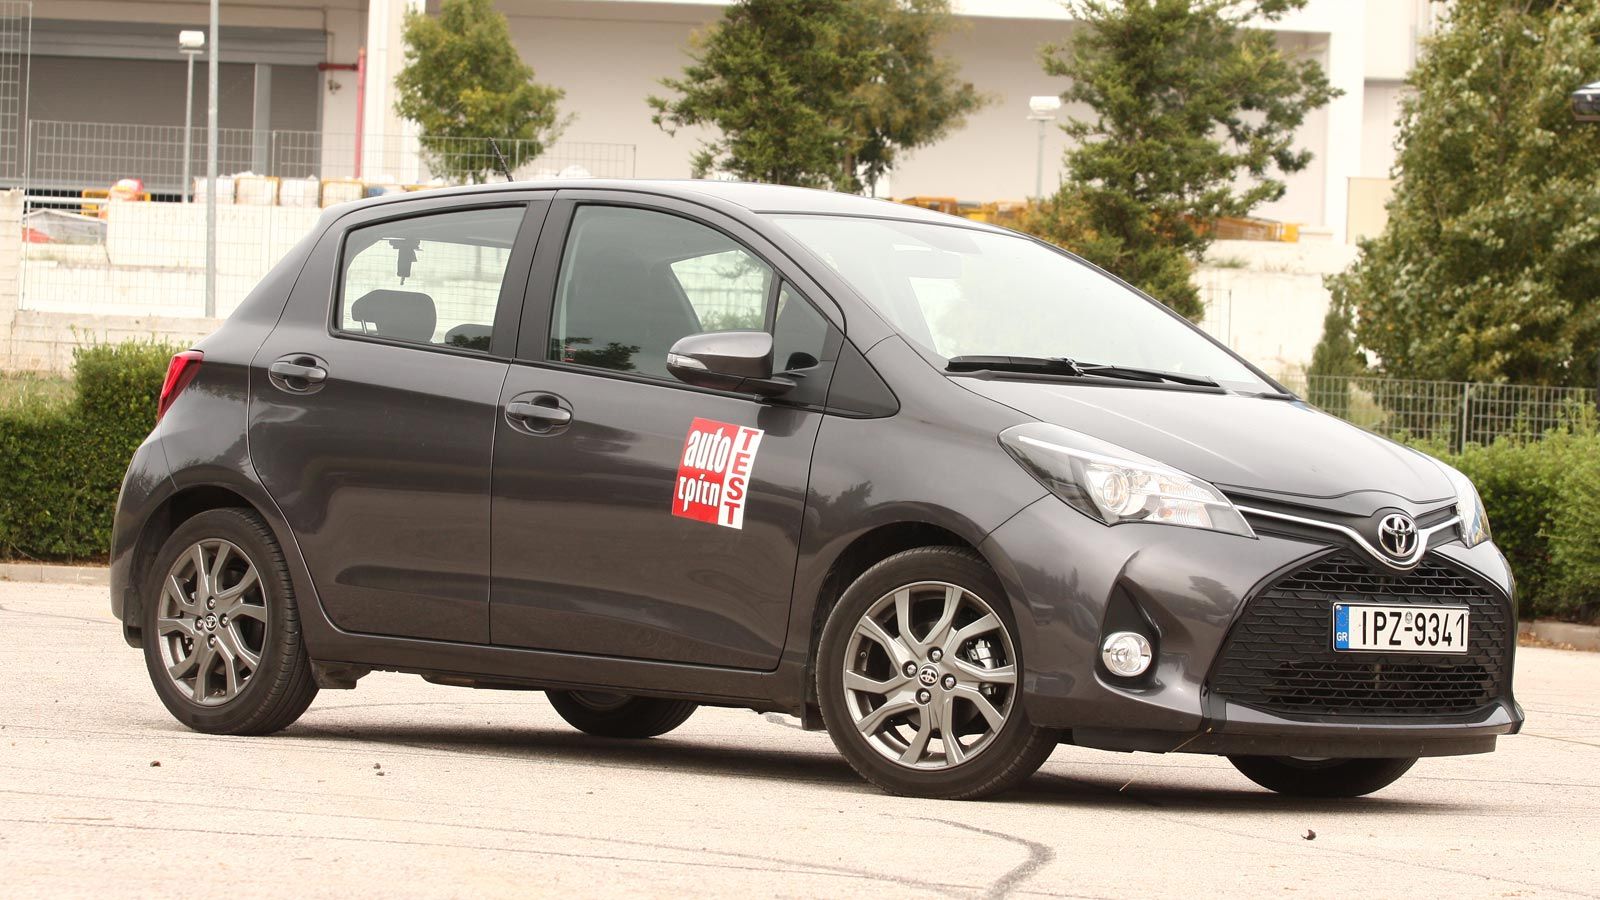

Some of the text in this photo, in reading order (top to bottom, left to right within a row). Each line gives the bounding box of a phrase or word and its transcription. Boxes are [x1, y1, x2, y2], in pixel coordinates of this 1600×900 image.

[683, 427, 732, 474] auto
[723, 428, 760, 525] TEST
[1336, 631, 1348, 642] GR
